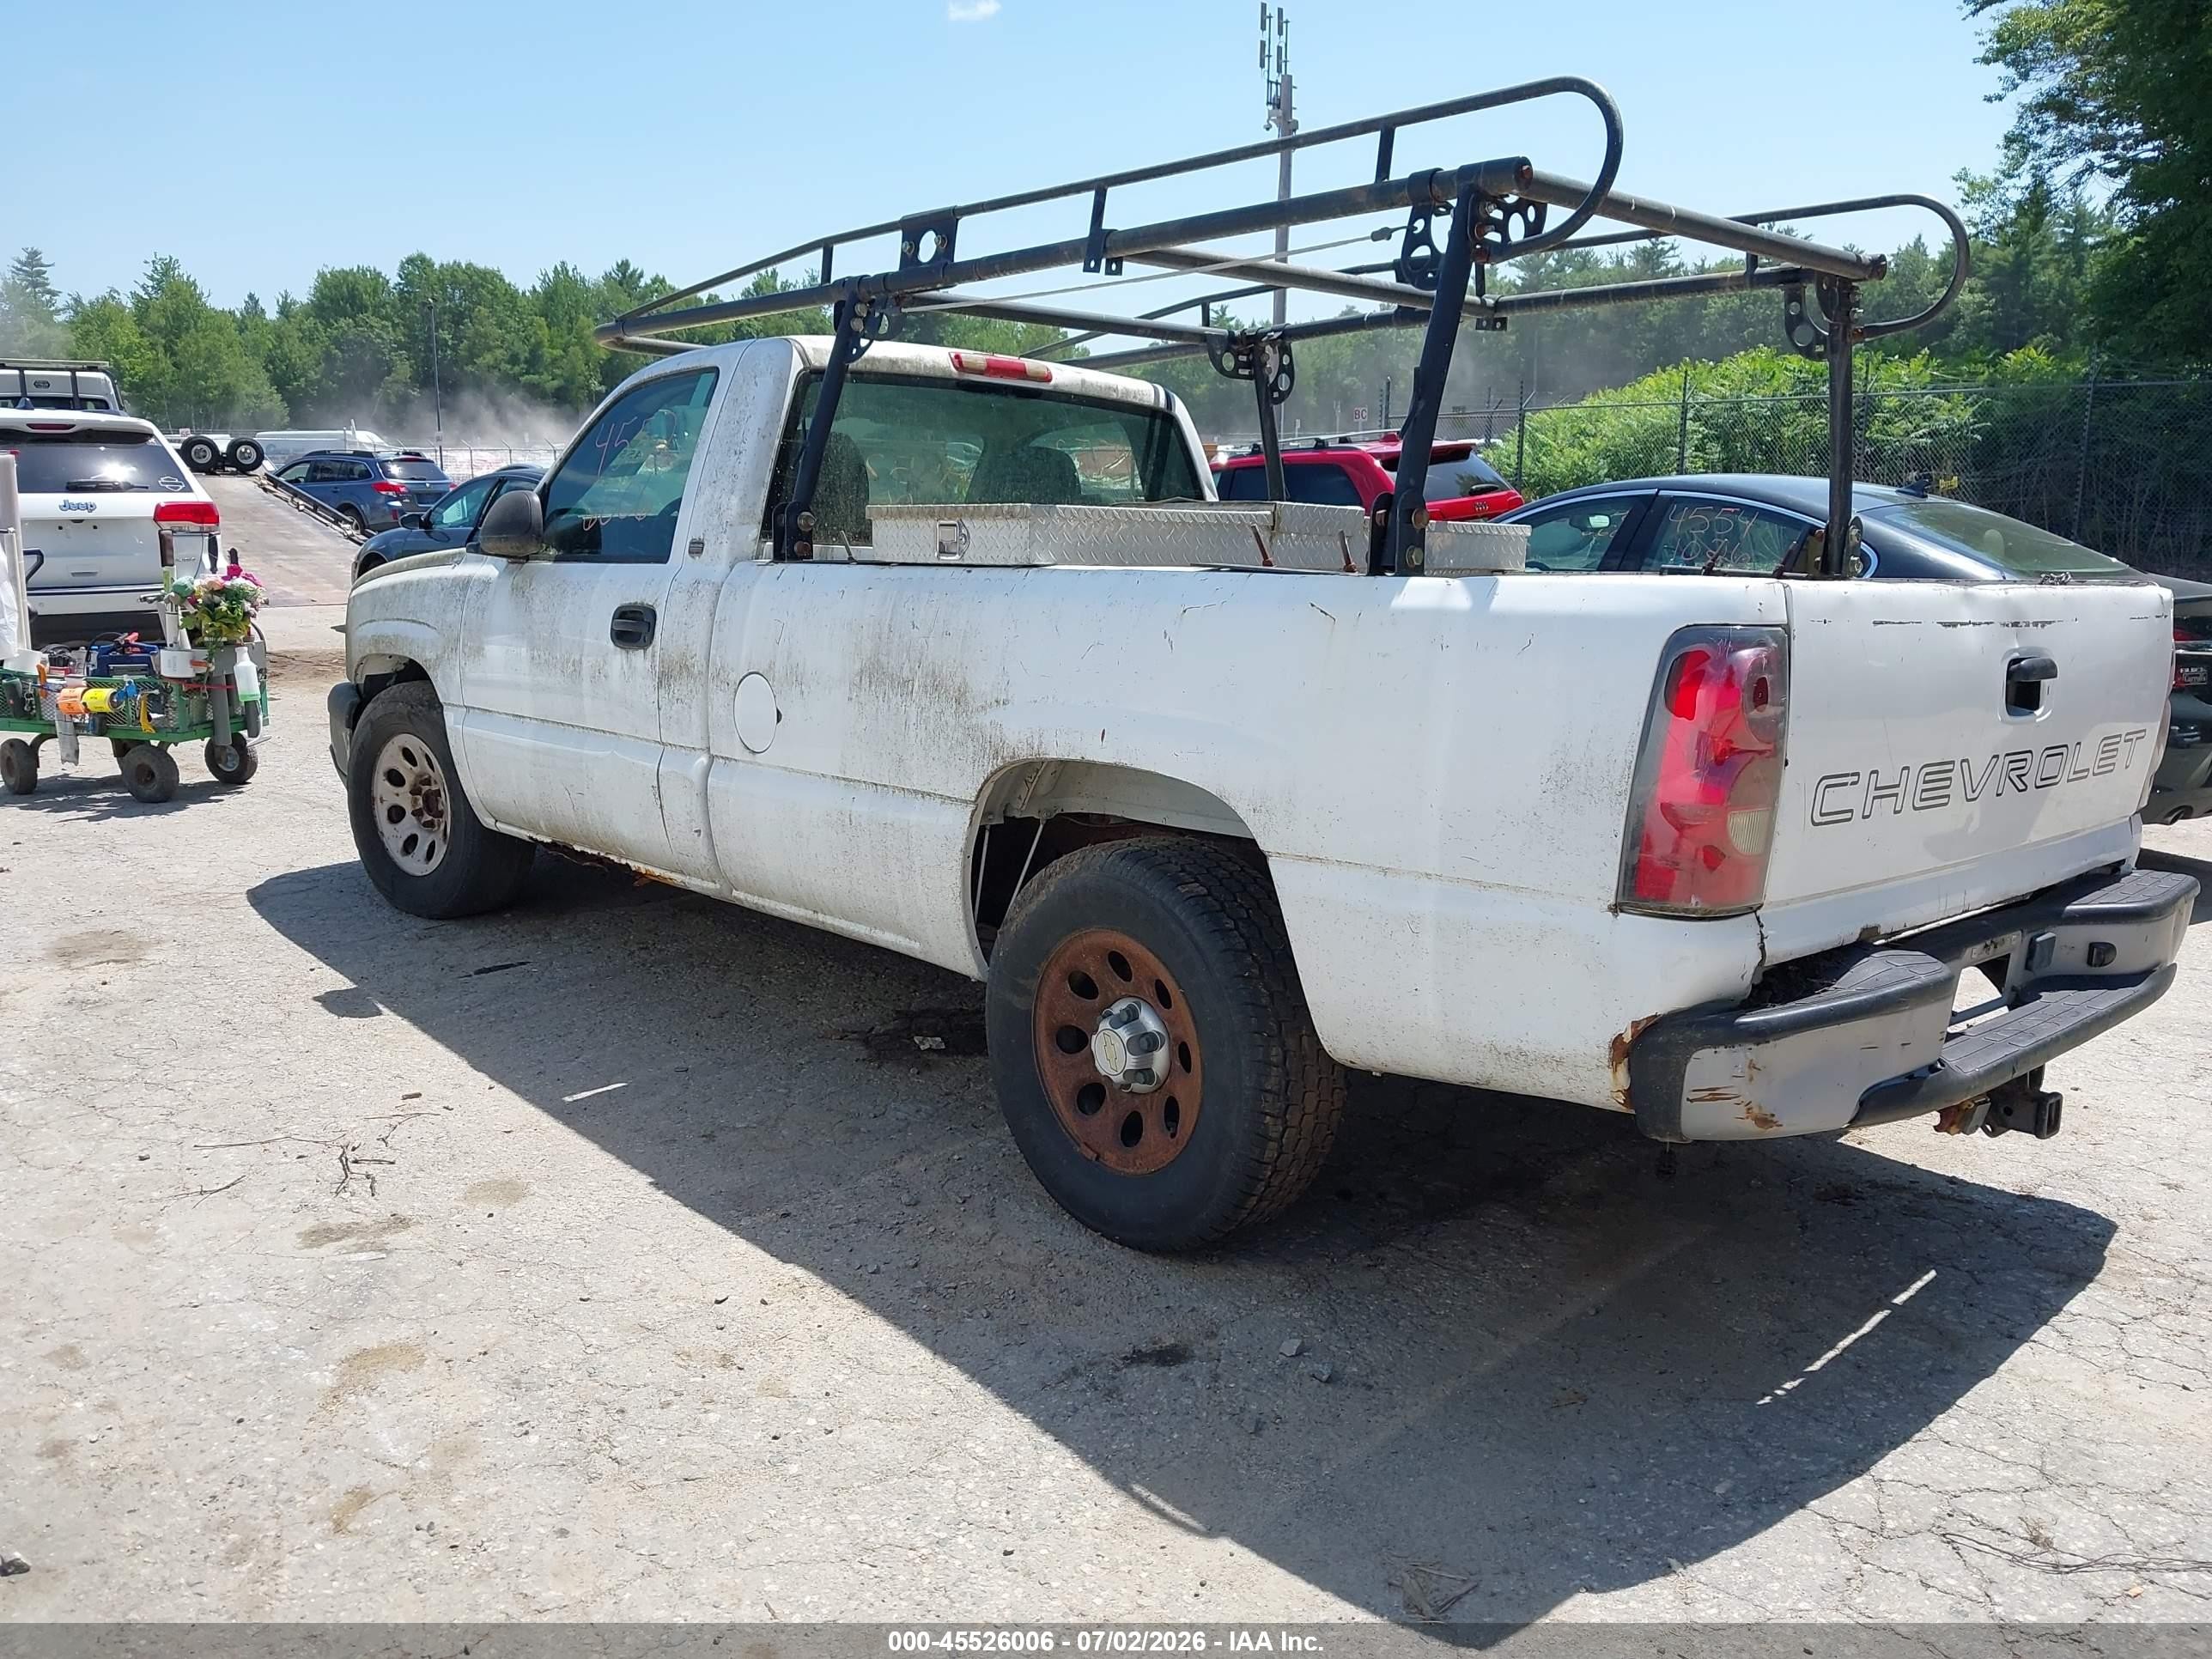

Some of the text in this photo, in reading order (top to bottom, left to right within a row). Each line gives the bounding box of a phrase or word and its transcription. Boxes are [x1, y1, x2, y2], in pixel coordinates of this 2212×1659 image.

[59, 500, 97, 513] Jeep
[1668, 504, 1759, 538] 4554
[1811, 729, 2146, 826] CHEVROLET
